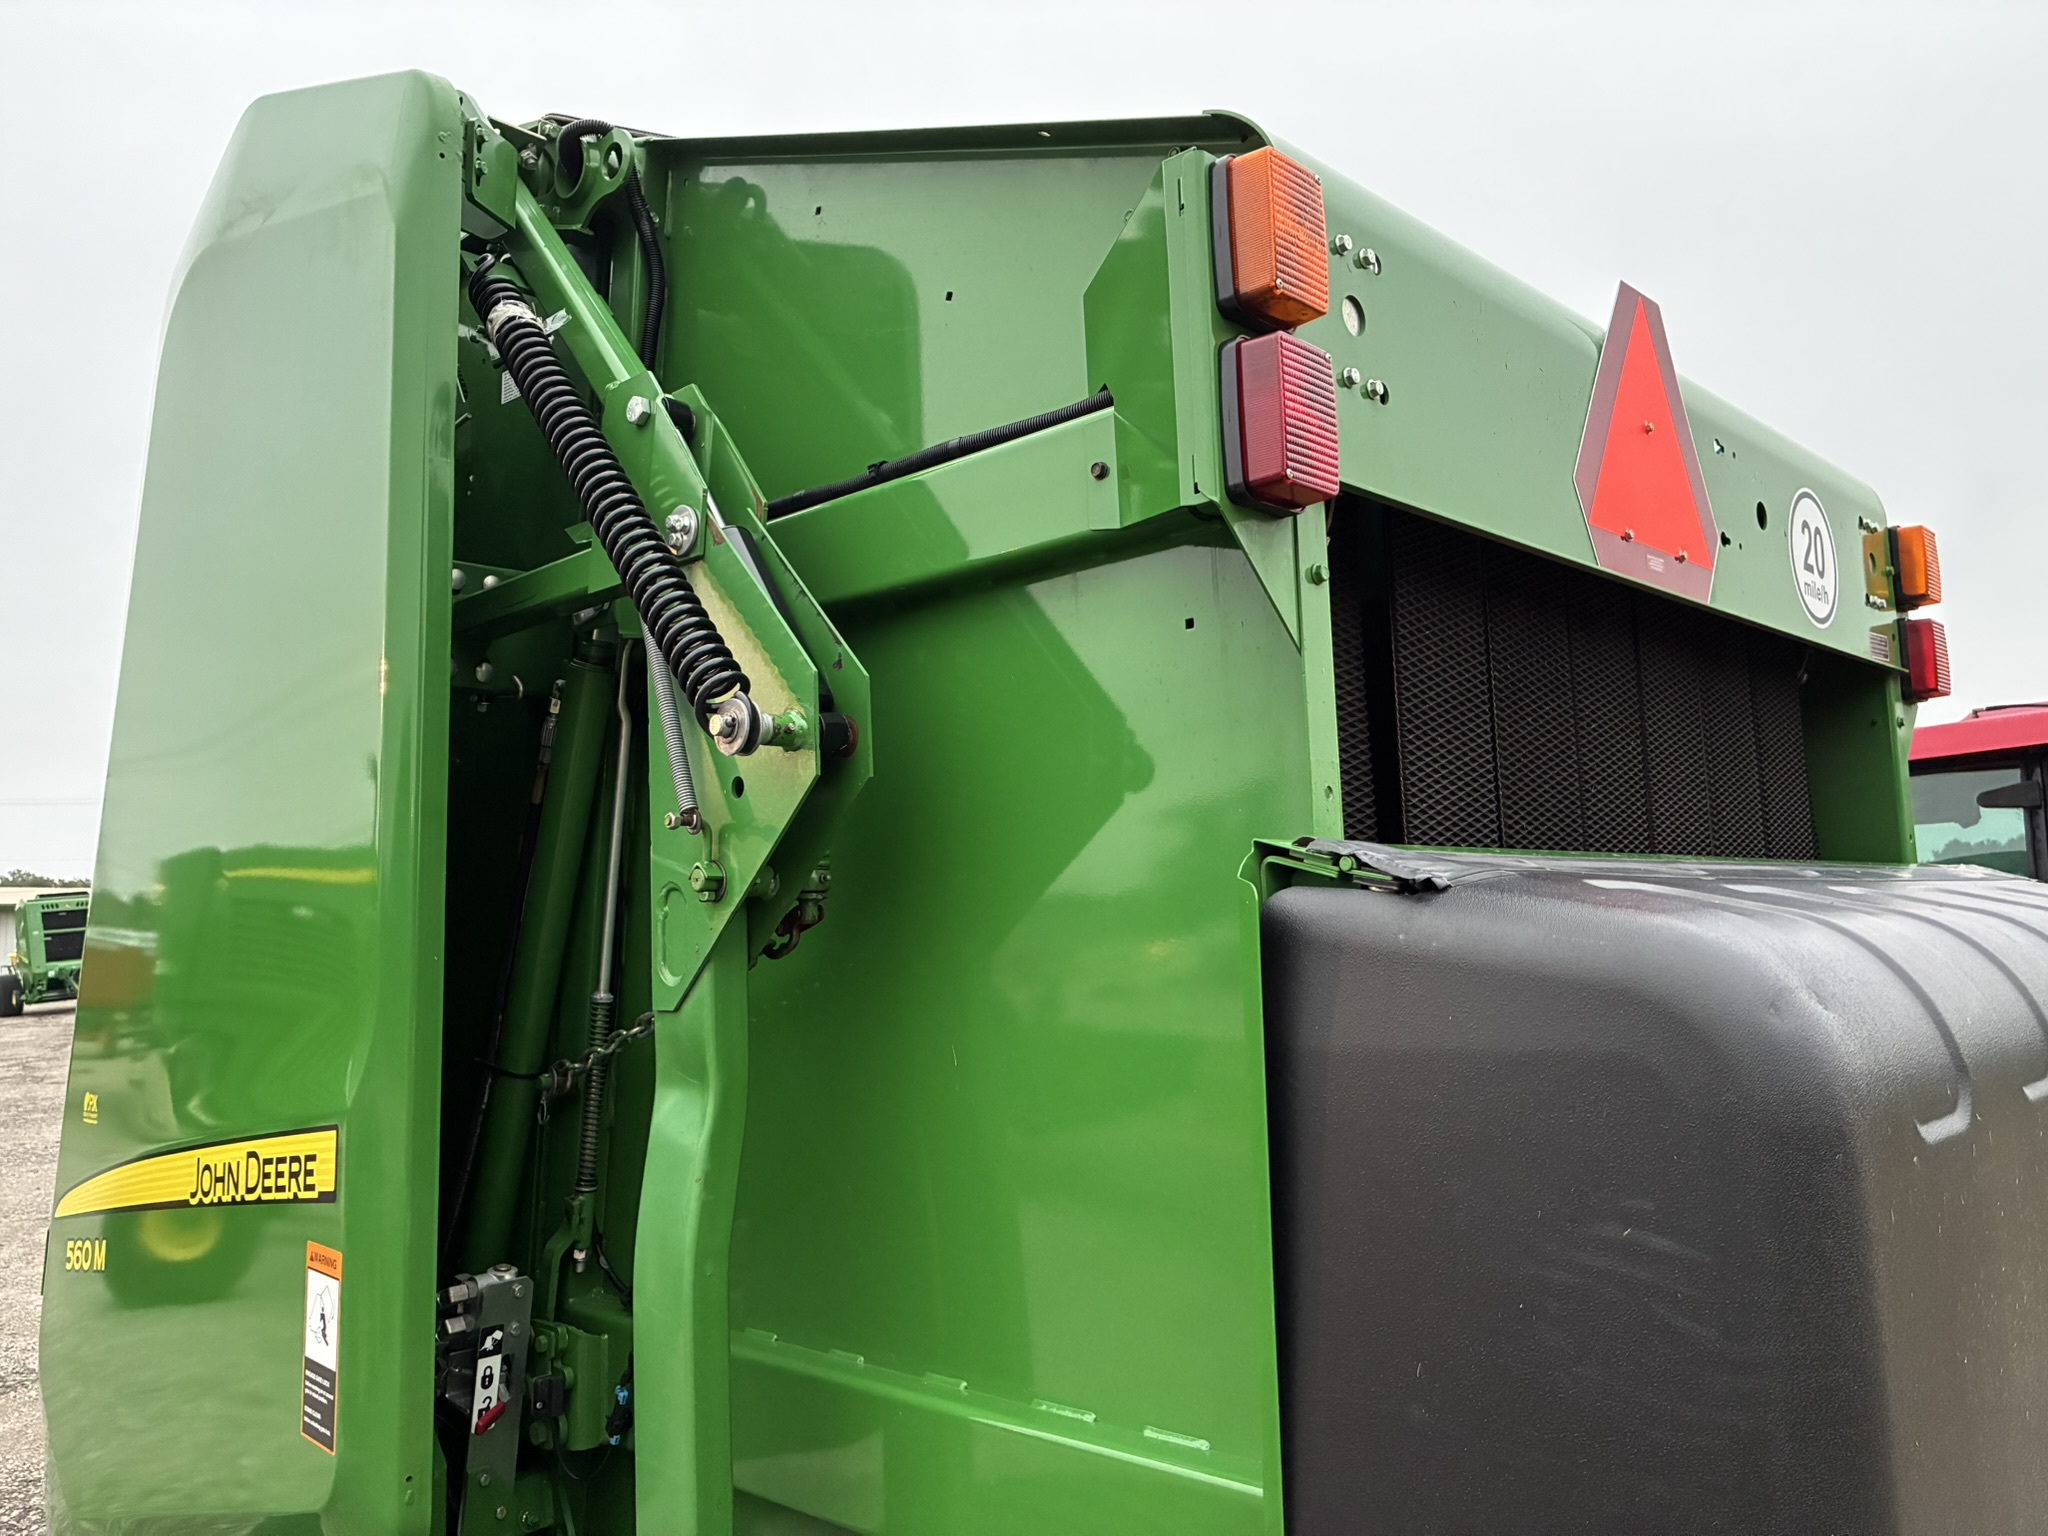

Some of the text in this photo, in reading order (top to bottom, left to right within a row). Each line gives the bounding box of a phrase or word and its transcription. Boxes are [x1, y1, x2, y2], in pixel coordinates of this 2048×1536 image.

[1801, 519, 1825, 579] 20
[190, 1151, 318, 1198] JOHN DEERE
[313, 1251, 337, 1270] WARNING
